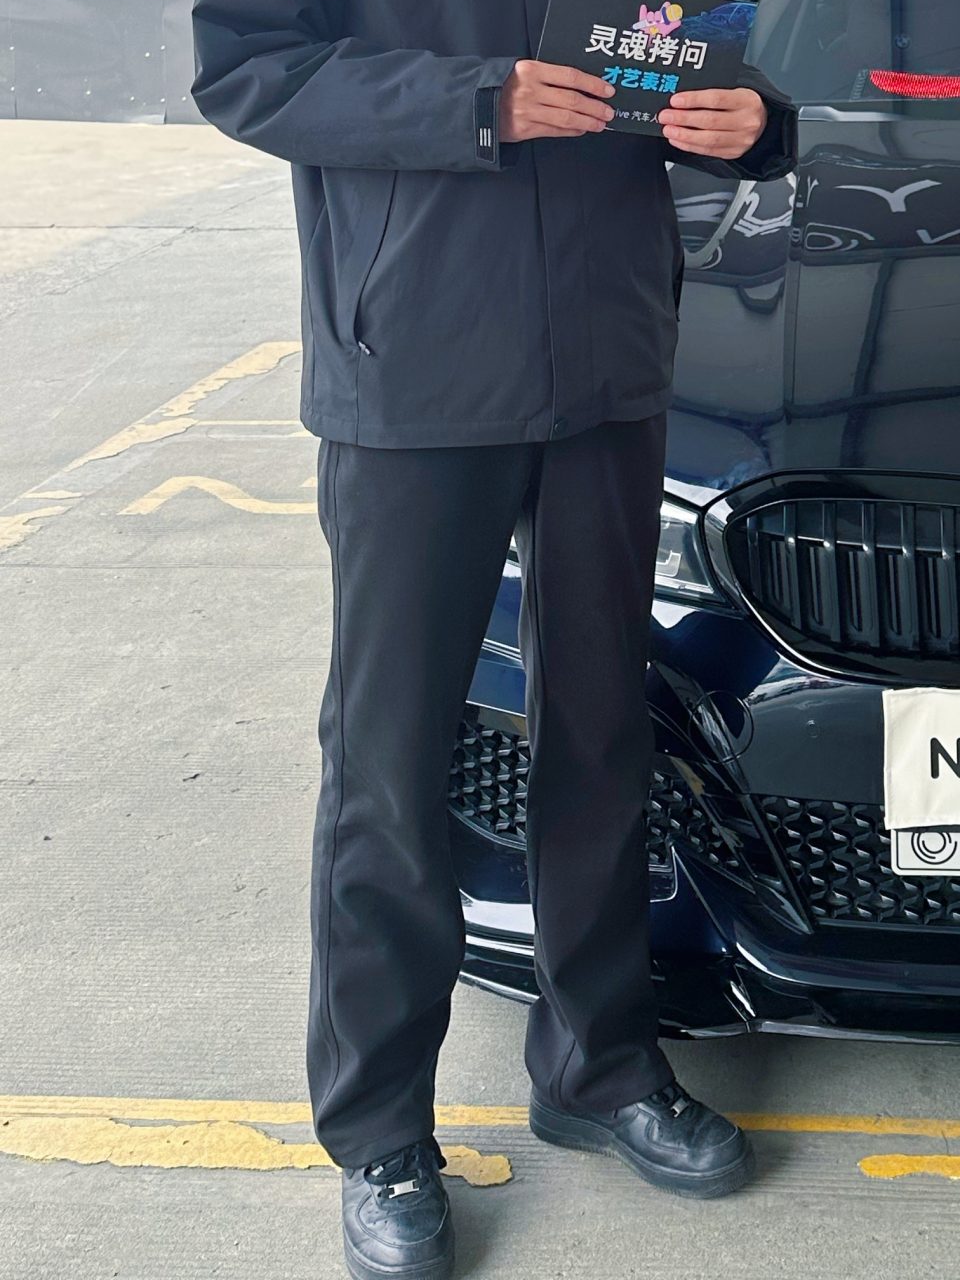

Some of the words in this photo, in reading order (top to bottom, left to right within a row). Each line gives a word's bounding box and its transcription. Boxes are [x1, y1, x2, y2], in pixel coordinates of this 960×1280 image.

[585, 23, 708, 70] 灵魂拷问
[602, 65, 680, 94] 才艺表演
[615, 107, 630, 119] ive
